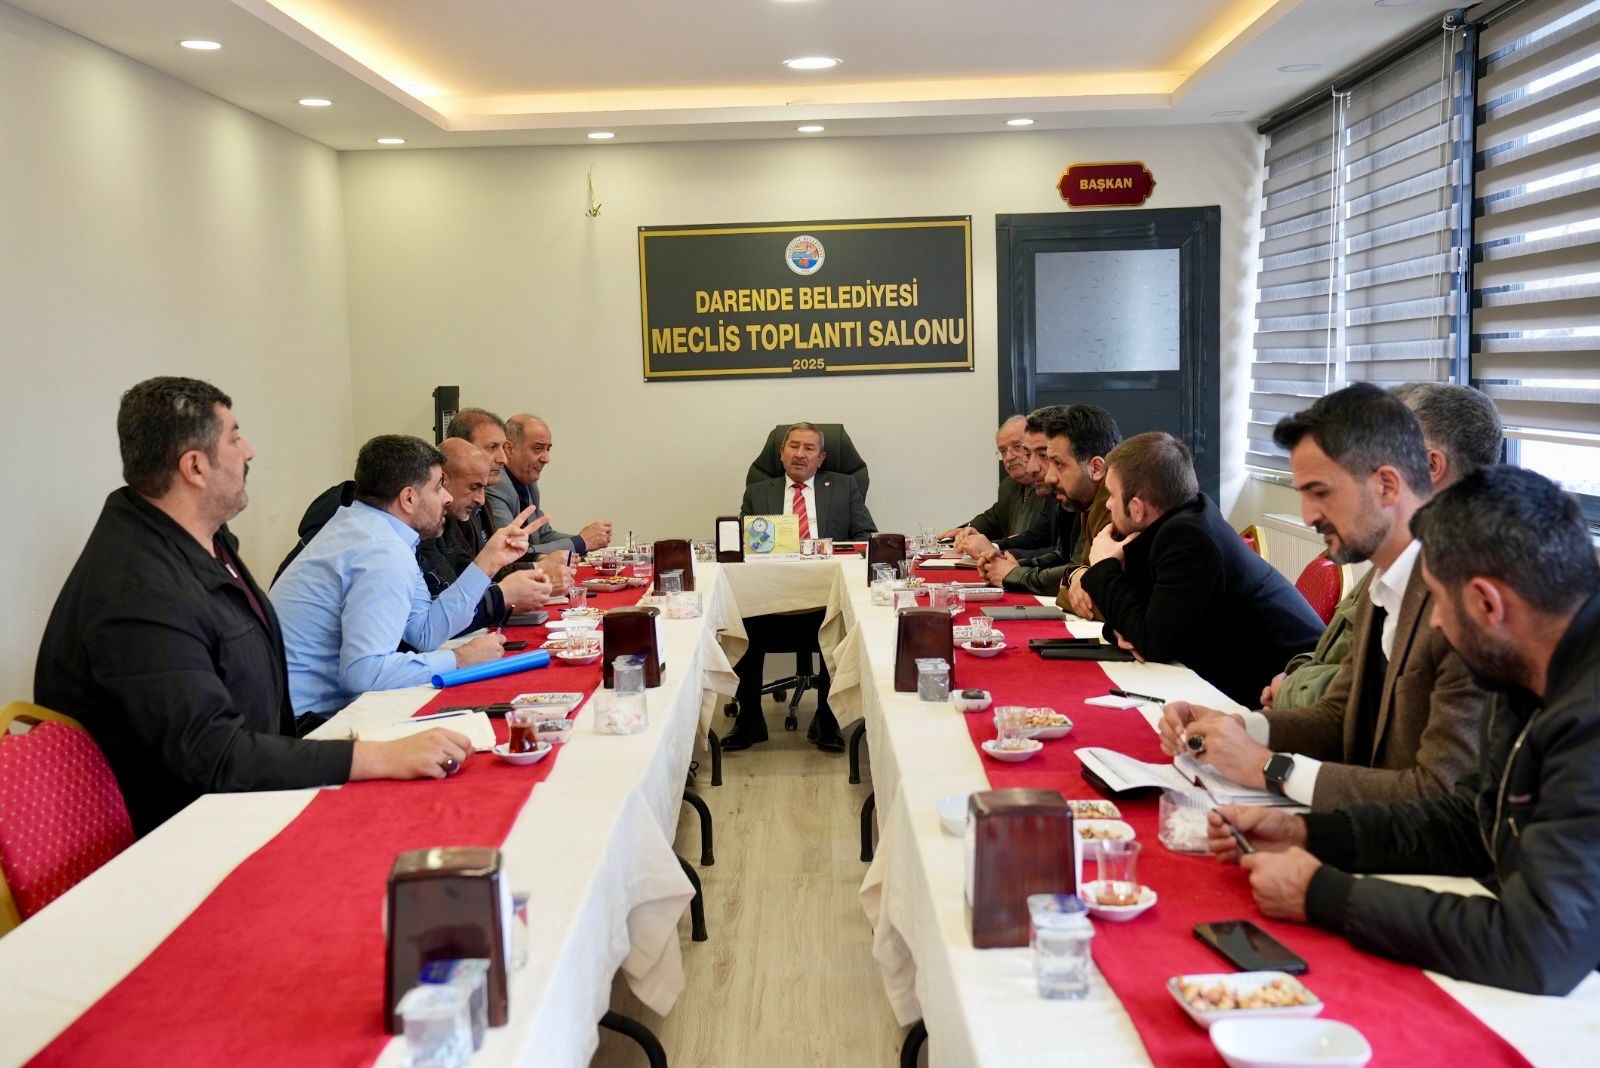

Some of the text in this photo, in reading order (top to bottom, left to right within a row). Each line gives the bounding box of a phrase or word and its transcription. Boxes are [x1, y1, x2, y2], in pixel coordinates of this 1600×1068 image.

[1080, 177, 1133, 192] BAŞKAN
[695, 277, 918, 314] DARENDE BELEDİYESİ
[651, 317, 965, 354] MECLİS TOPLANTI SALONU
[792, 358, 825, 370] 2025
